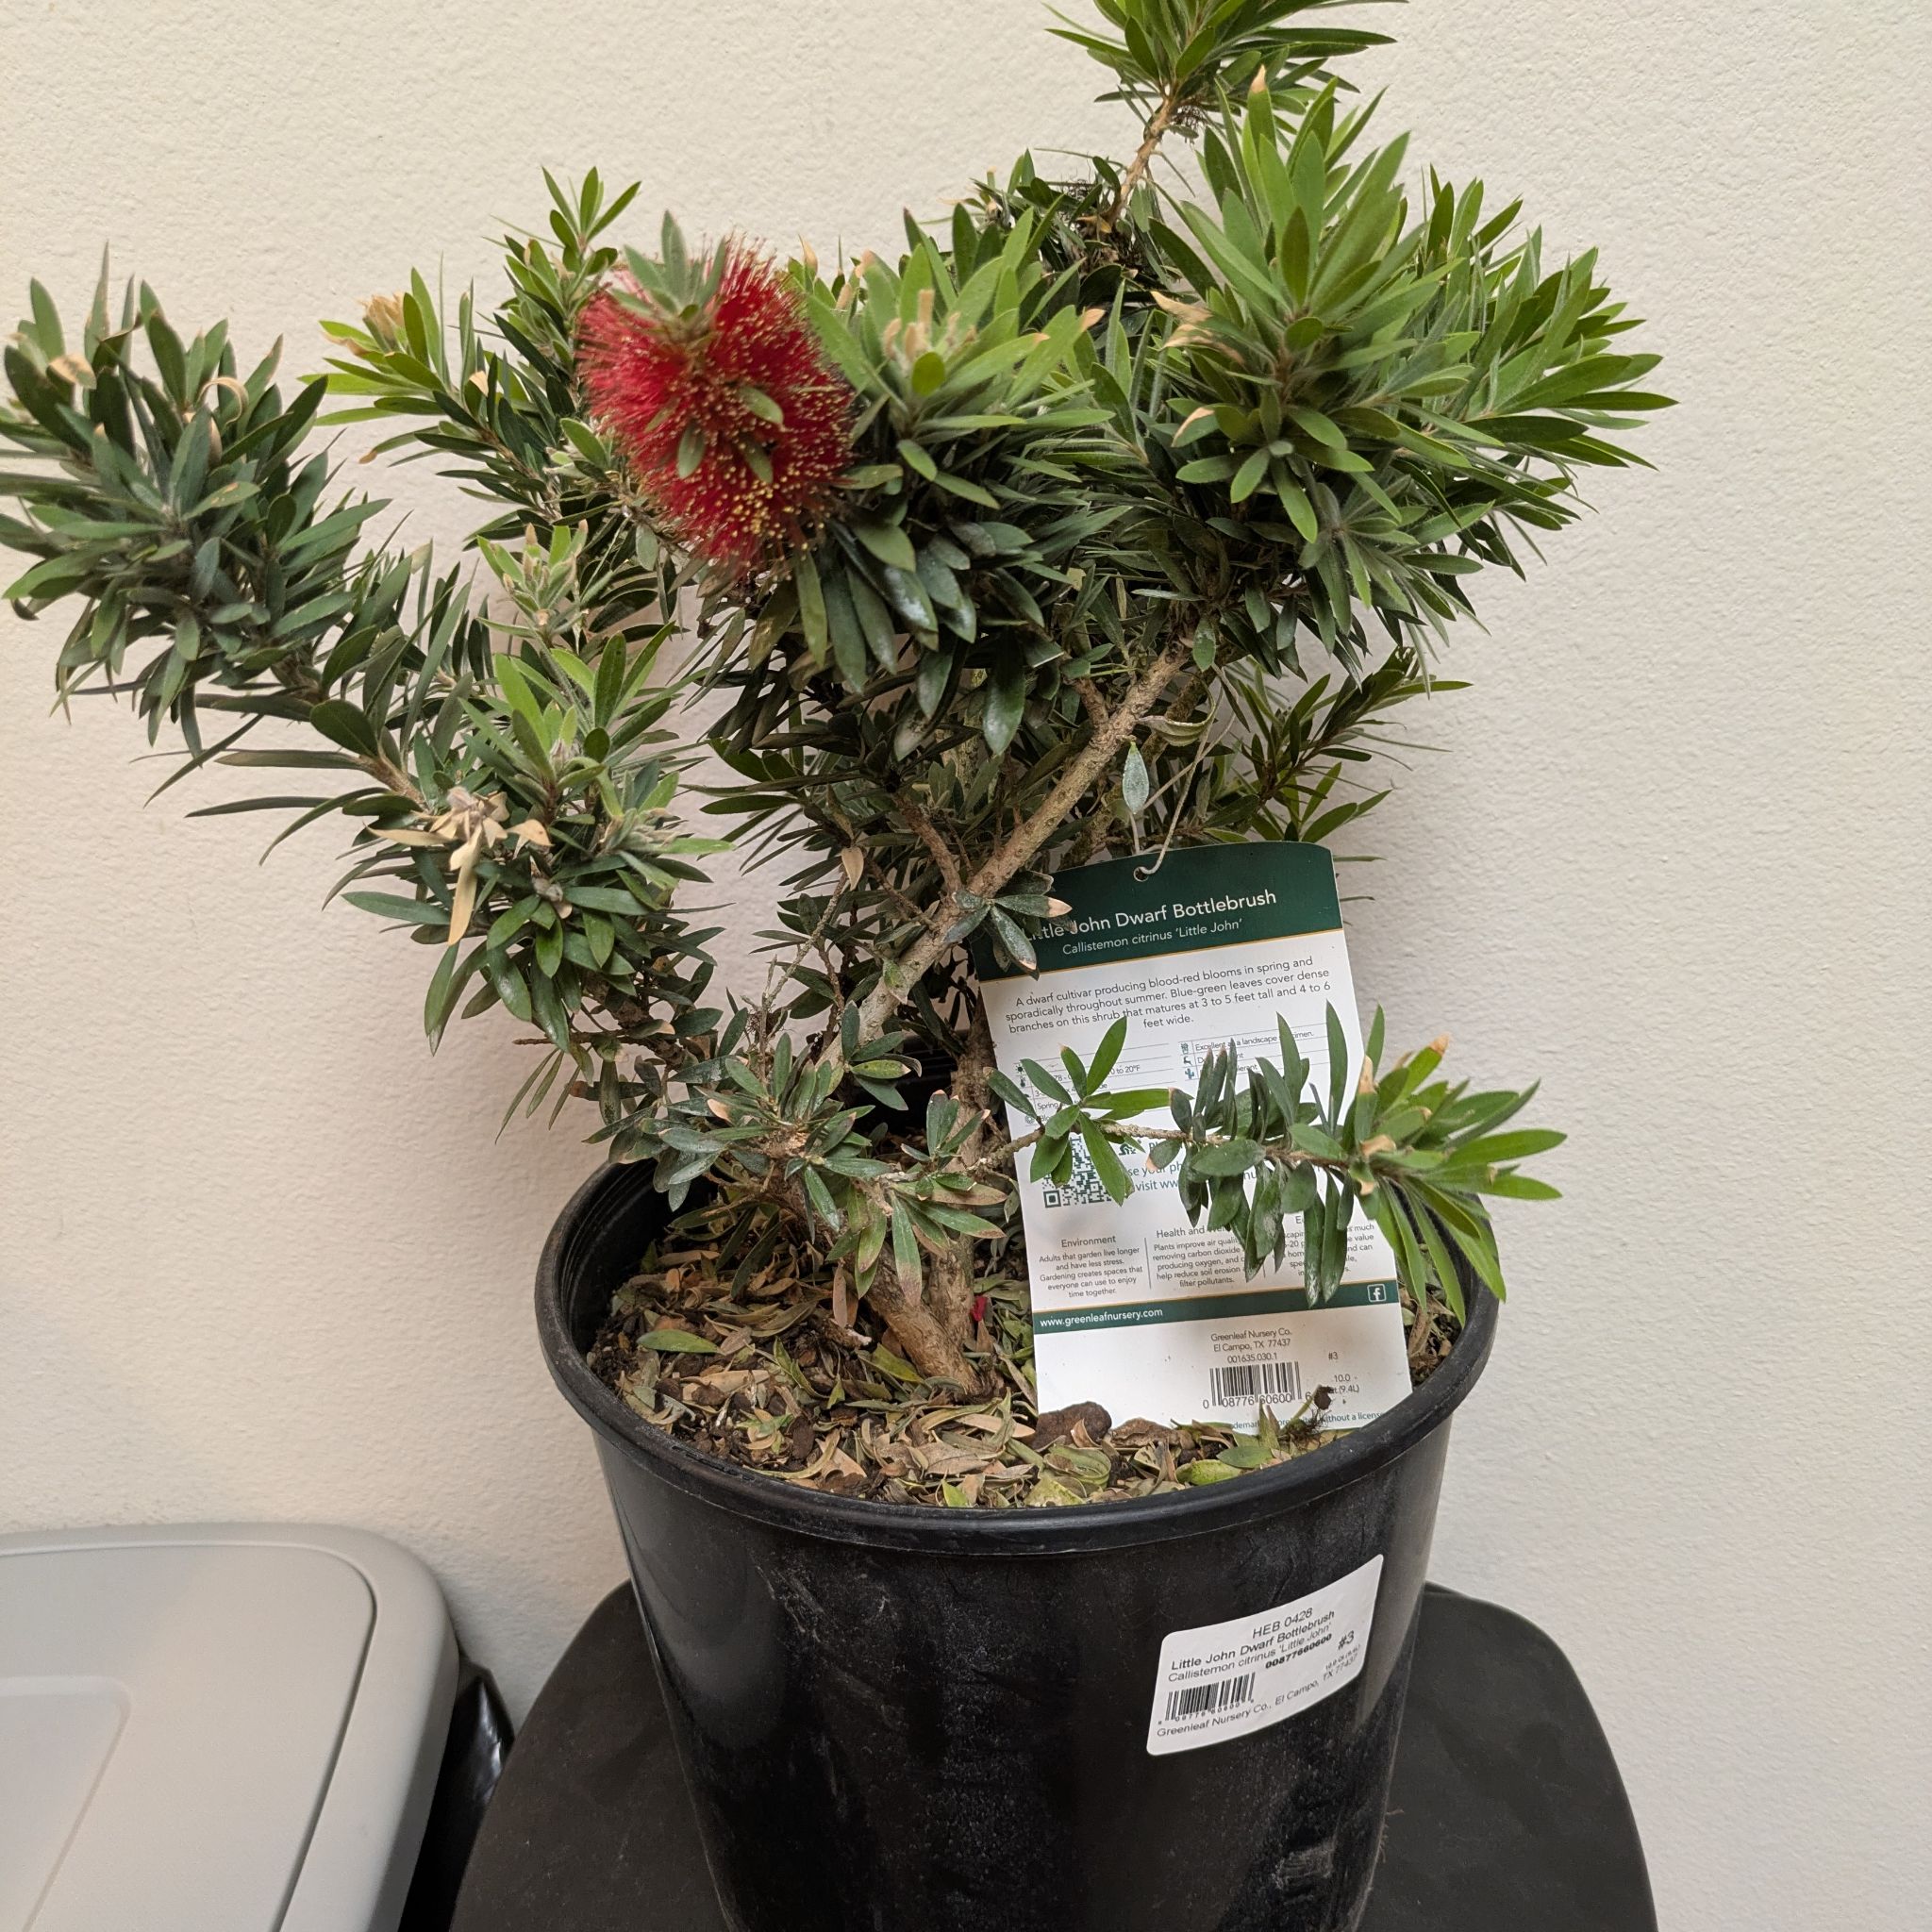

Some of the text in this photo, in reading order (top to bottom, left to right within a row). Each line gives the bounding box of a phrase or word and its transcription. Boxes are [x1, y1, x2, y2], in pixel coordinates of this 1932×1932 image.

[1029, 889, 1276, 941] tle John Dwarf Bottlebrush
[1062, 937, 1128, 955] Callistemon
[1132, 931, 1172, 944] citrinus
[1210, 918, 1242, 933] John'
[1015, 956, 1313, 1007] A dwarf cultivar producing blood-red blooms in spring and
[1006, 969, 1329, 1023] sporadically throughout summer. Blue-green leaves cover dense
[1008, 981, 1331, 1034] branches on this shrub that matures at 3 to 5 feet tall and 4 to 6
[1143, 1014, 1194, 1029] feet wide.
[1195, 1041, 1225, 1051] Excellent
[1241, 1036, 1277, 1045] landscape
[1135, 1180, 1158, 1191] visit
[1156, 1227, 1186, 1239] Health
[1188, 1225, 1205, 1235] and
[1354, 1223, 1374, 1231] much
[1061, 1236, 1116, 1248] Environment
[1176, 1241, 1205, 1250] improve
[1039, 1254, 1060, 1262] Adults
[1062, 1253, 1076, 1261] that
[1077, 1250, 1102, 1260] garden
[1117, 1246, 1140, 1257] longer
[1152, 1251, 1186, 1261] removing
[1187, 1249, 1211, 1257] carbon
[1157, 1266, 1241, 1280] help reduce soil erosion
[1158, 1260, 1193, 1272] producing
[1195, 1259, 1223, 1268] oxygen,
[1040, 1272, 1075, 1282] Gardening
[1077, 1269, 1102, 1277] creates
[1104, 1268, 1127, 1277] spaces
[1179, 1276, 1235, 1289] filter pollutants.
[1047, 1281, 1079, 1291] everyone
[1117, 1276, 1137, 1286] enjoy
[1086, 1287, 1116, 1298] together.
[1040, 1308, 1163, 1327] www.greenleafnursery.com
[1210, 1327, 1292, 1341] Greenleaf Nursery Co.
[1213, 1338, 1291, 1353] El Campo, TX 77437
[1227, 1352, 1277, 1364] 001635.030.1
[1328, 1351, 1339, 1360] #3
[1334, 1374, 1351, 1383] 10.0
[1203, 1391, 1312, 1409] 0 08776 60600 6
[1252, 1607, 1313, 1639] HEB 0428
[1171, 1610, 1335, 1671] Little John Dwarf Bottlebrush
[1338, 1630, 1355, 1651] #3
[1168, 1662, 1235, 1682] Callistemon
[1238, 1649, 1276, 1667] citrinus
[1157, 1720, 1209, 1737] Greenleaf
[1211, 1707, 1251, 1726] Nursery
[1274, 1695, 1284, 1706] El
